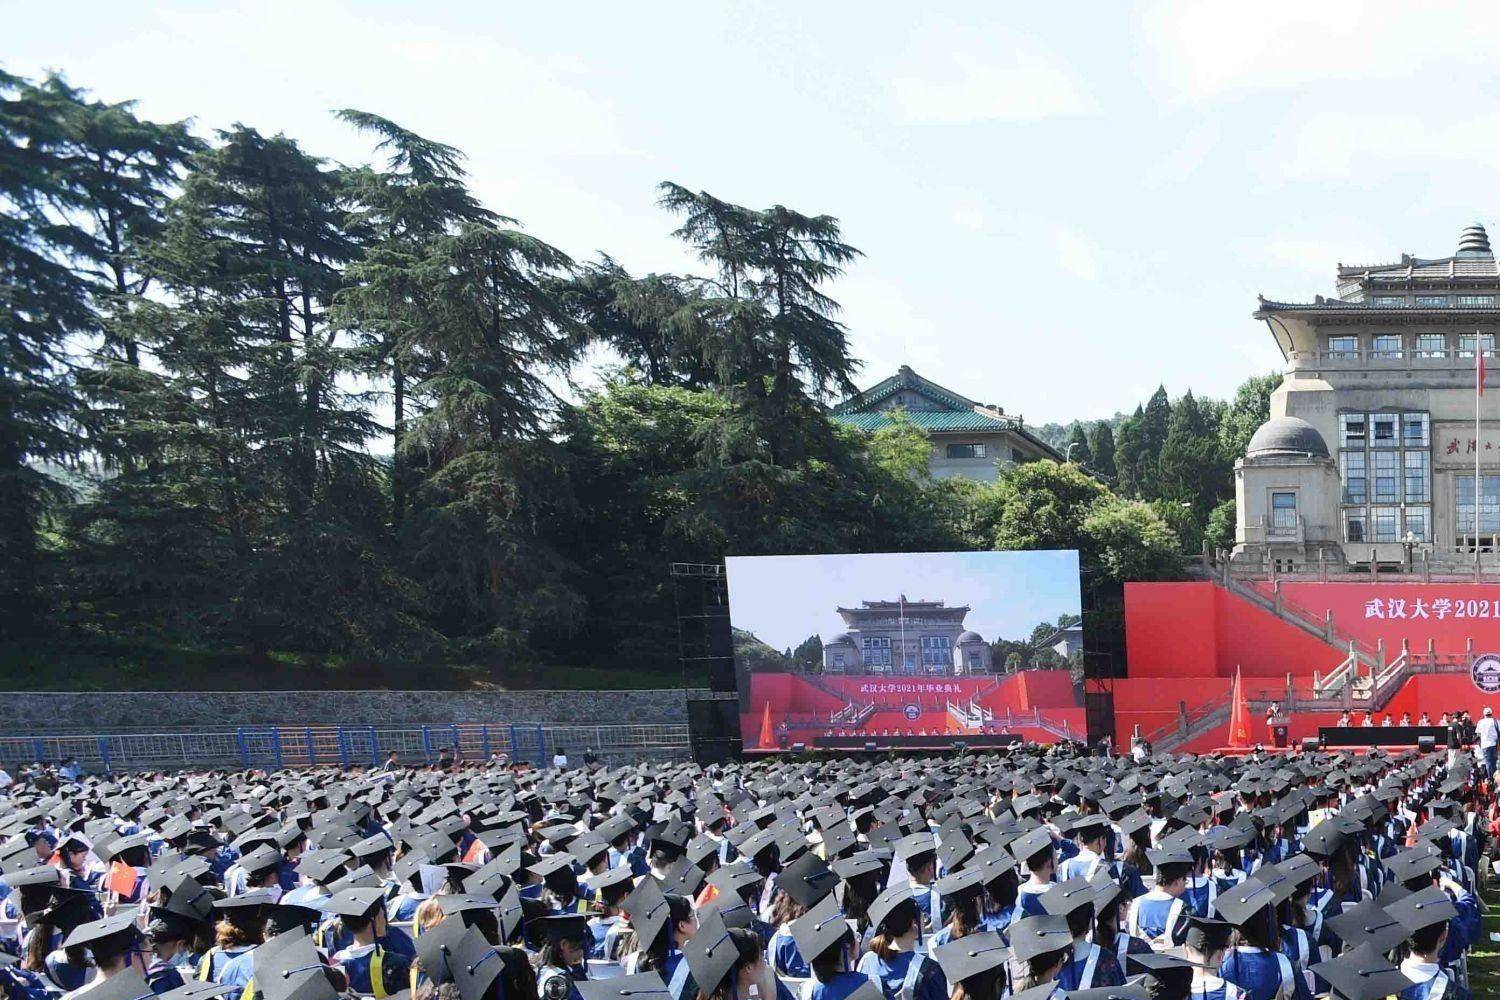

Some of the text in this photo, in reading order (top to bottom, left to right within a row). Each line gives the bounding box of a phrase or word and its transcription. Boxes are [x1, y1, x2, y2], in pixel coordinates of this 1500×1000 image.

[860, 683, 962, 693] 武汉大学2021年毕业典礼
